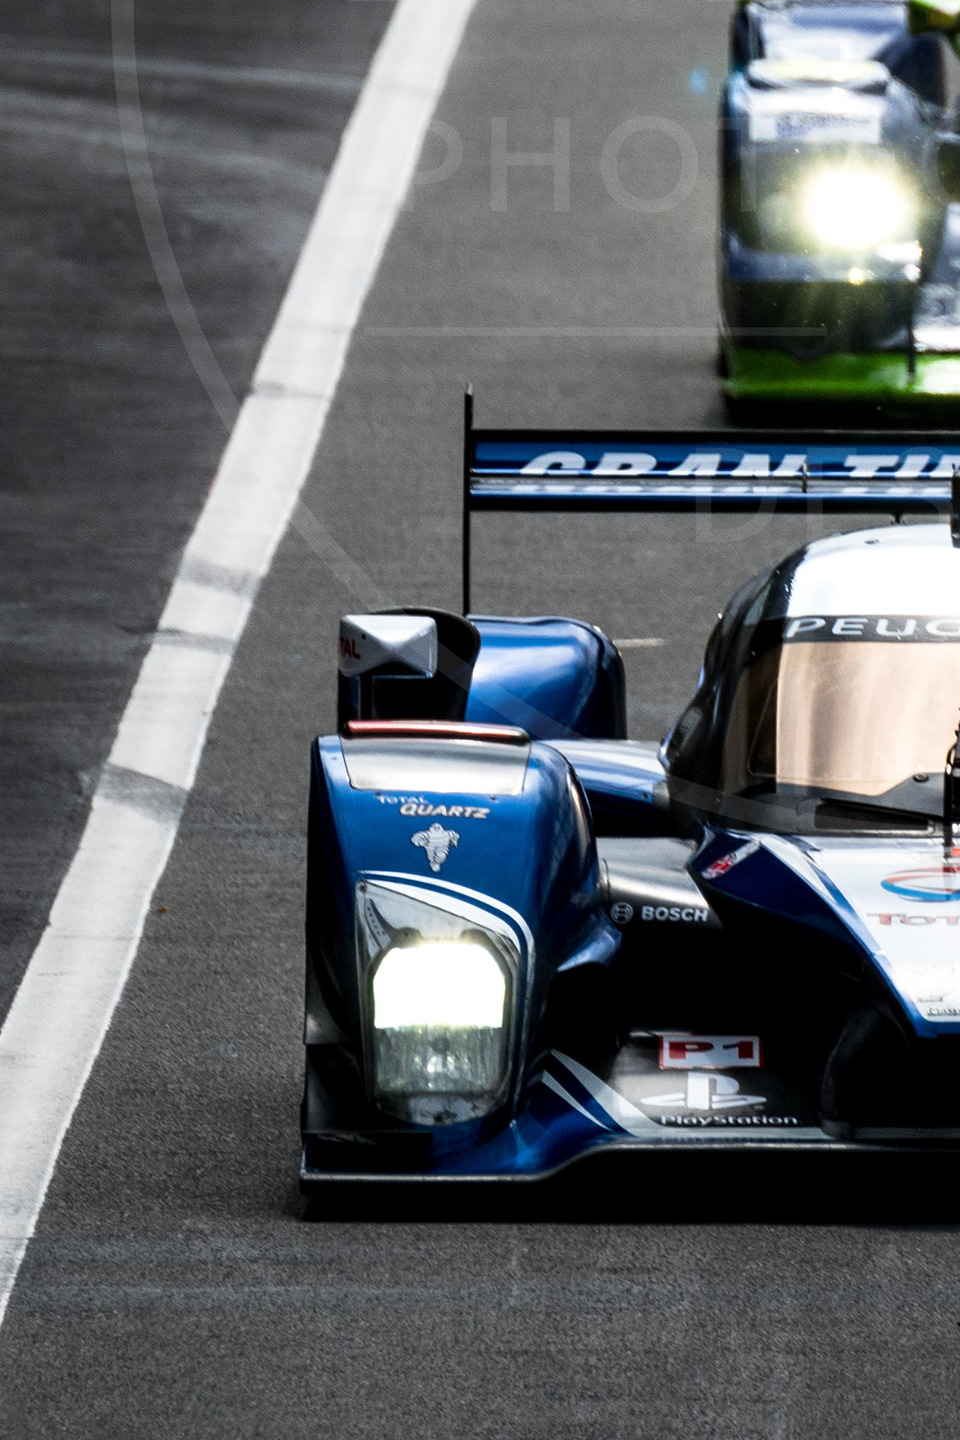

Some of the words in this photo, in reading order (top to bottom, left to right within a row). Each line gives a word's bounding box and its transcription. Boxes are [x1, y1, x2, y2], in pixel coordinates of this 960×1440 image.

[399, 803, 490, 819] QUARTZ
[641, 906, 709, 922] BOSCH
[668, 1040, 755, 1060] P1
[660, 1115, 798, 1127] PlayStation
